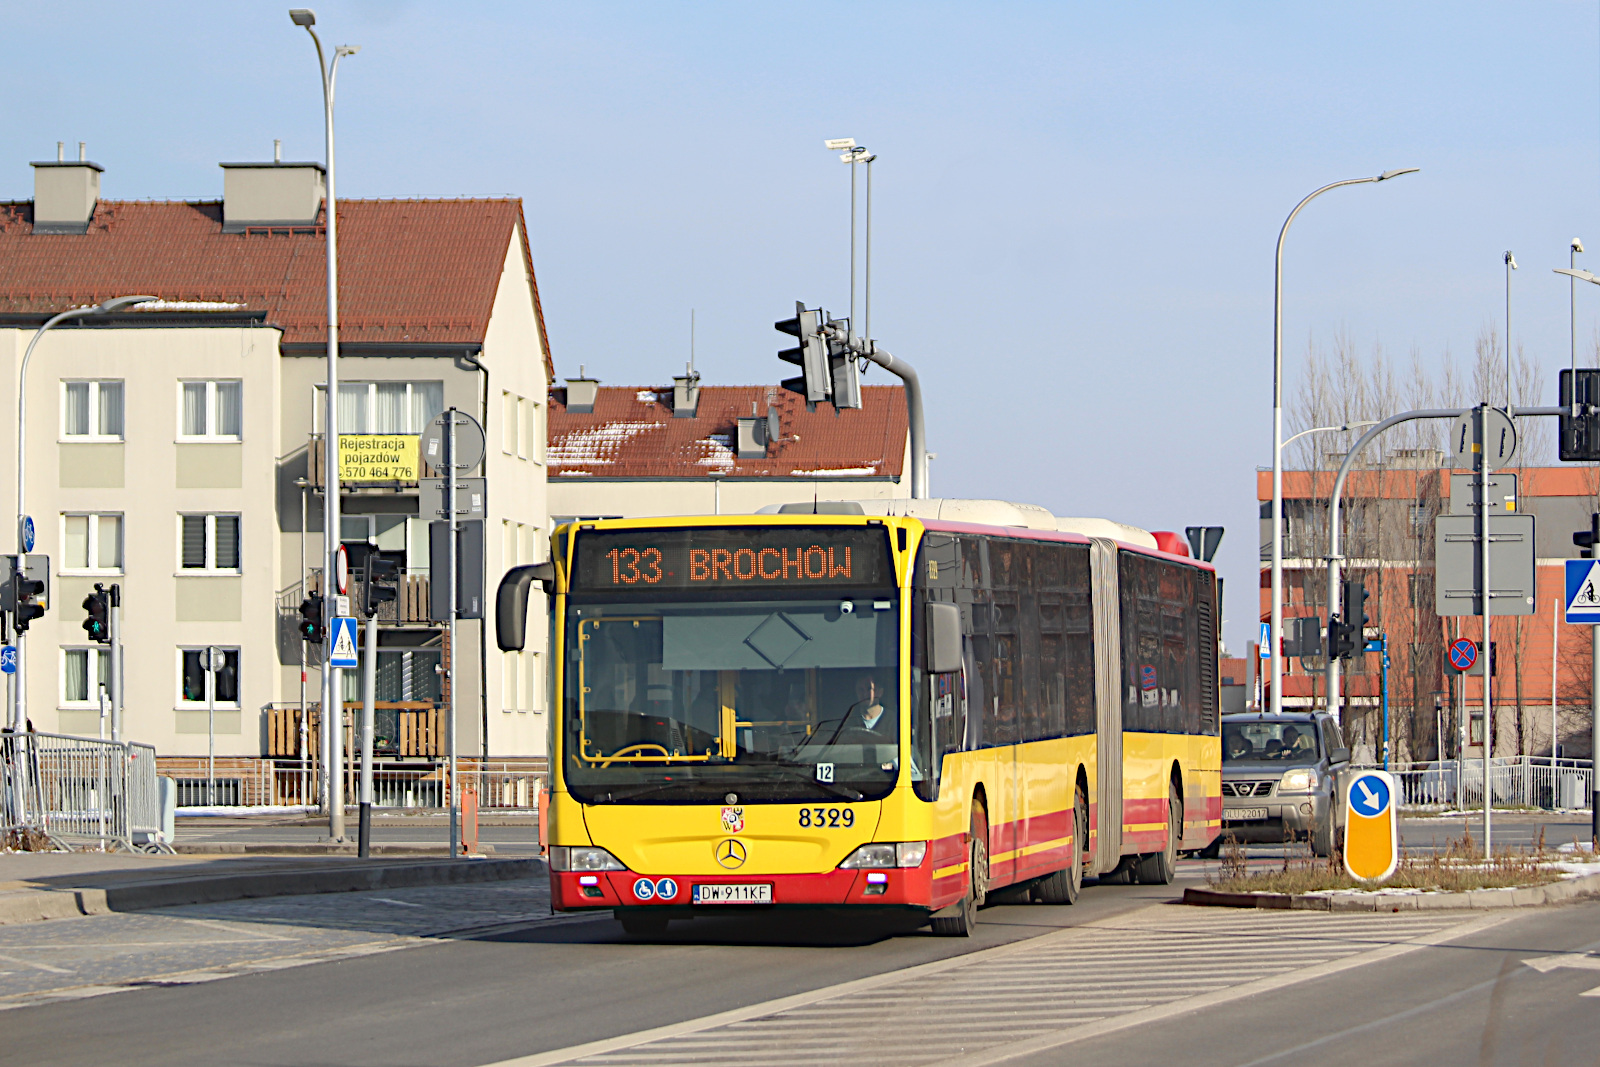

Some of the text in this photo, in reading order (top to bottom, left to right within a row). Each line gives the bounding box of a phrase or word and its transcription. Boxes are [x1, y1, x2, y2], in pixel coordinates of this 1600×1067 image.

[340, 437, 405, 452] Rejestracja
[344, 451, 400, 466] pojazdów
[345, 466, 412, 478] 570 464 776
[605, 544, 852, 584] 133 BROCHÓW
[818, 765, 832, 780] 12
[798, 807, 855, 829] 8329
[1241, 809, 1266, 818] 22017
[702, 886, 767, 900] DW 911KF
